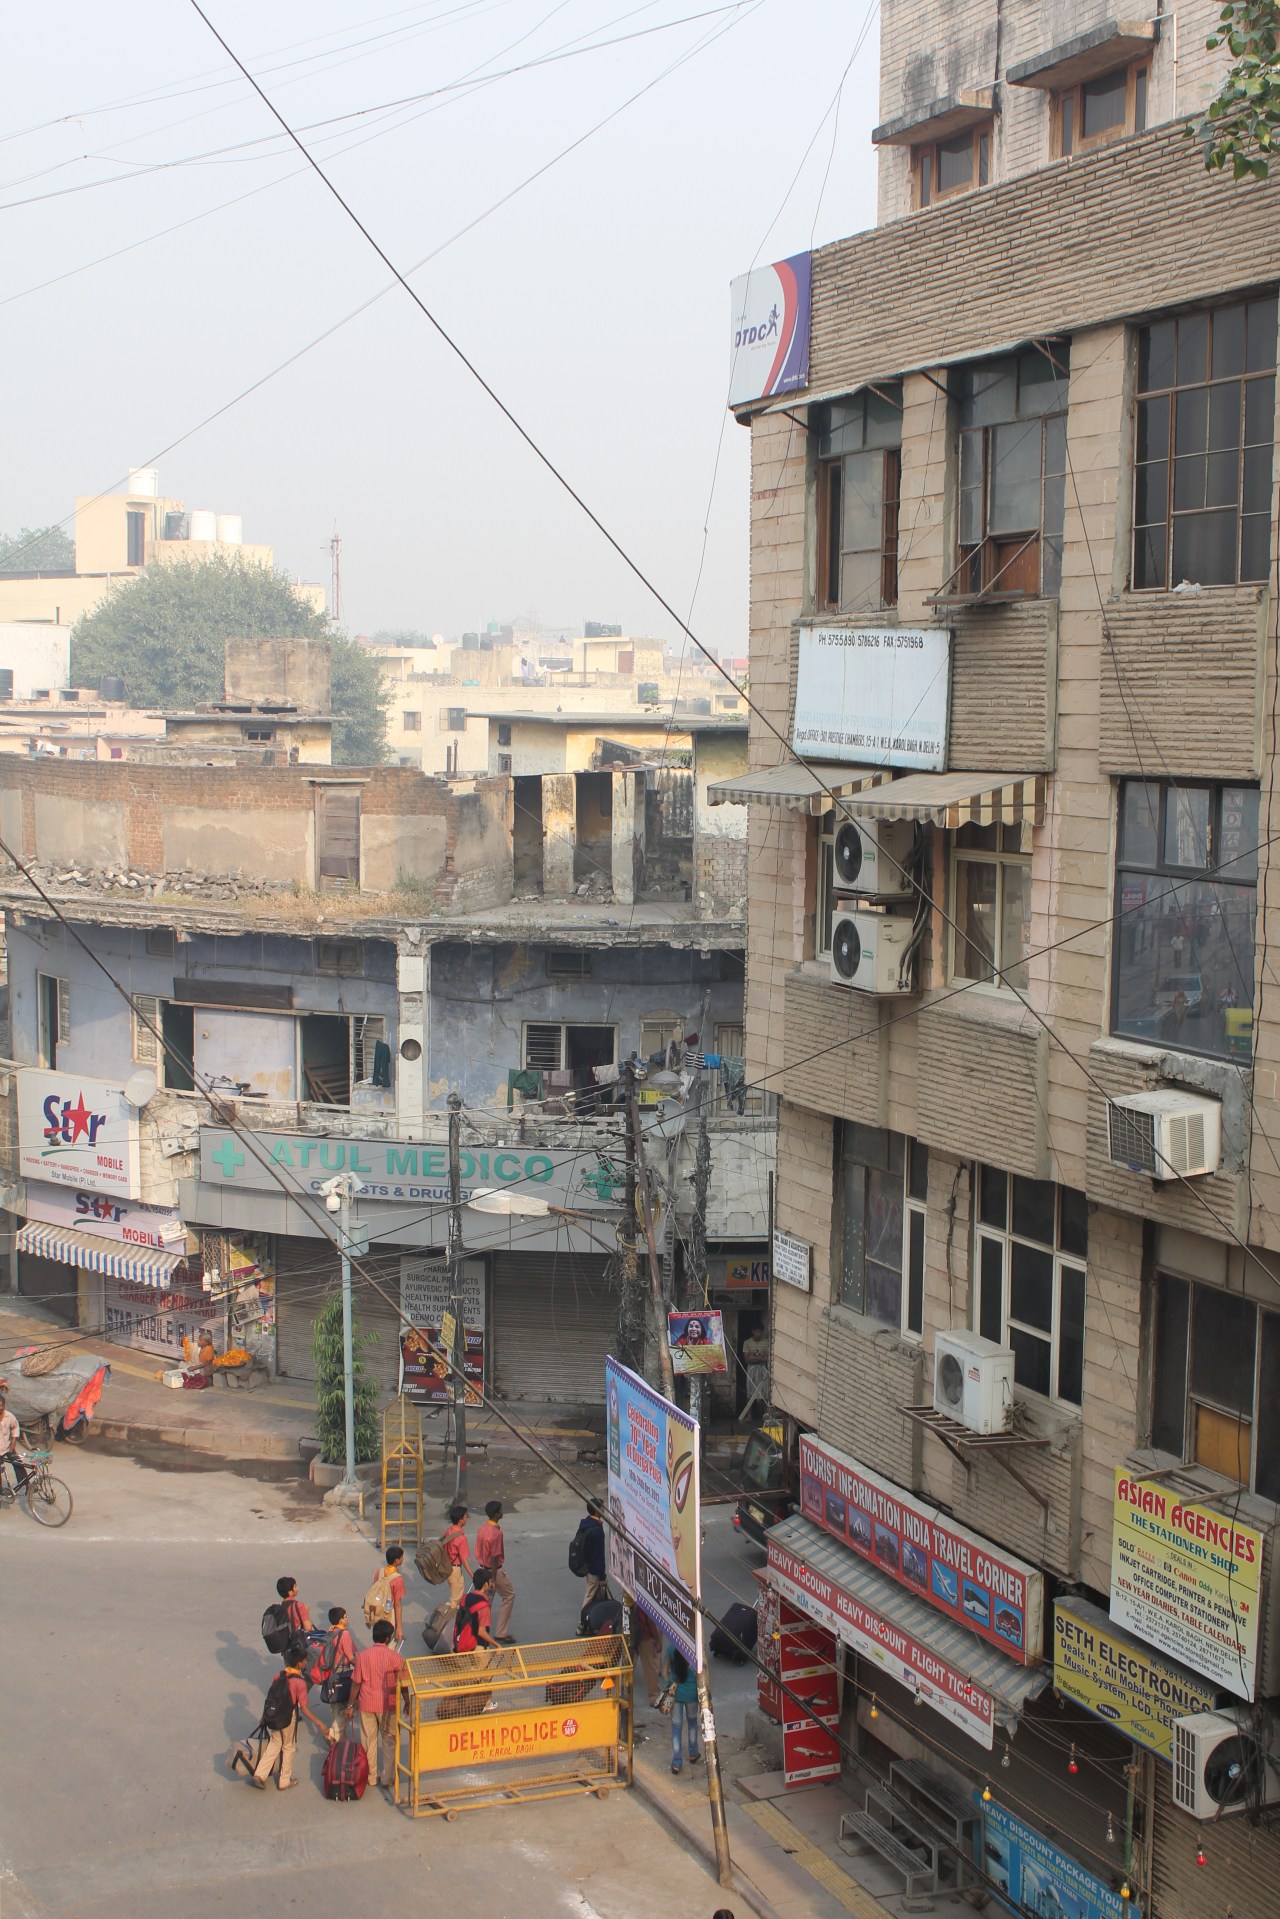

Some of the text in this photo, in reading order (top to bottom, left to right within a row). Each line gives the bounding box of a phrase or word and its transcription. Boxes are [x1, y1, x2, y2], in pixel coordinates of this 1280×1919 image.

[735, 323, 767, 348] DTDC
[897, 636, 924, 649] 5751968
[62, 1173, 78, 1183] Mobile
[83, 1168, 98, 1177] CHARGER
[96, 1155, 123, 1171] MOBILE
[269, 1140, 555, 1182] ATUL MEDICO
[393, 1188, 404, 1197] &
[122, 1227, 165, 1248] MOBILE
[405, 1284, 442, 1292] AYURVEDIC
[407, 1274, 440, 1283] SURGICAL
[405, 1303, 431, 1311] HEALTH
[410, 1313, 435, 1321] DERMO
[627, 1402, 659, 1444] Celebrating
[633, 1446, 649, 1474] Durga
[649, 1460, 662, 1486] Puja
[641, 1433, 657, 1462] Year
[801, 1444, 1023, 1608] TOURIST INFORMATION INDIA TRAVEL CORNER
[1118, 1479, 1255, 1563] ASIAN AGENCIES
[1130, 1512, 1148, 1530] THE
[1150, 1521, 1208, 1560] STATIONERY
[1210, 1553, 1239, 1575] SHOP
[1170, 1552, 1187, 1566] DEALS
[1118, 1537, 1135, 1553] SOLO
[1173, 1567, 1197, 1586] Canon
[1198, 1580, 1213, 1595] Oddy
[646, 1566, 659, 1598] PC
[659, 1581, 691, 1630] Jeweller
[1119, 1552, 1140, 1570] INKJET
[1142, 1565, 1178, 1591] CARTRIDGE,
[1179, 1584, 1206, 1606] PRINTER
[1207, 1599, 1212, 1608] &
[1214, 1602, 1247, 1627] PENDRIVE
[1133, 1573, 1229, 1631] OFFICE COMPUTER STATIONERY
[767, 1545, 792, 1573] HEAVY
[794, 1562, 832, 1601] DISCOUNT
[837, 1593, 864, 1624] HEAVY
[865, 1613, 907, 1655] DISCOUNT
[911, 1646, 945, 1683] FLIGHT
[1117, 1576, 1247, 1655] NEW YEAR DIARIES, TABLE CALENDARS
[1166, 1619, 1185, 1635] KAROL
[1205, 1641, 1219, 1654] NEW
[1055, 1615, 1212, 1713] SETH ELECTRONICS
[1061, 1637, 1085, 1661] Deals
[1087, 1652, 1096, 1667] In
[1104, 1665, 1117, 1681] All
[1119, 1675, 1151, 1701] Mobile
[1064, 1654, 1090, 1678] Music
[1092, 1673, 1129, 1705] System,
[1132, 1696, 1154, 1719] LCD,
[1062, 1679, 1155, 1740] BlackBerry SAMSUNG NOKIA
[449, 1728, 495, 1753] DELHI
[501, 1720, 558, 1745] POLICE
[489, 1747, 512, 1758] KAROL
[980, 1799, 1007, 1825] HEAVY
[1009, 1820, 1053, 1859] DISCOUNT
[1055, 1855, 1098, 1894] PACKAGE
